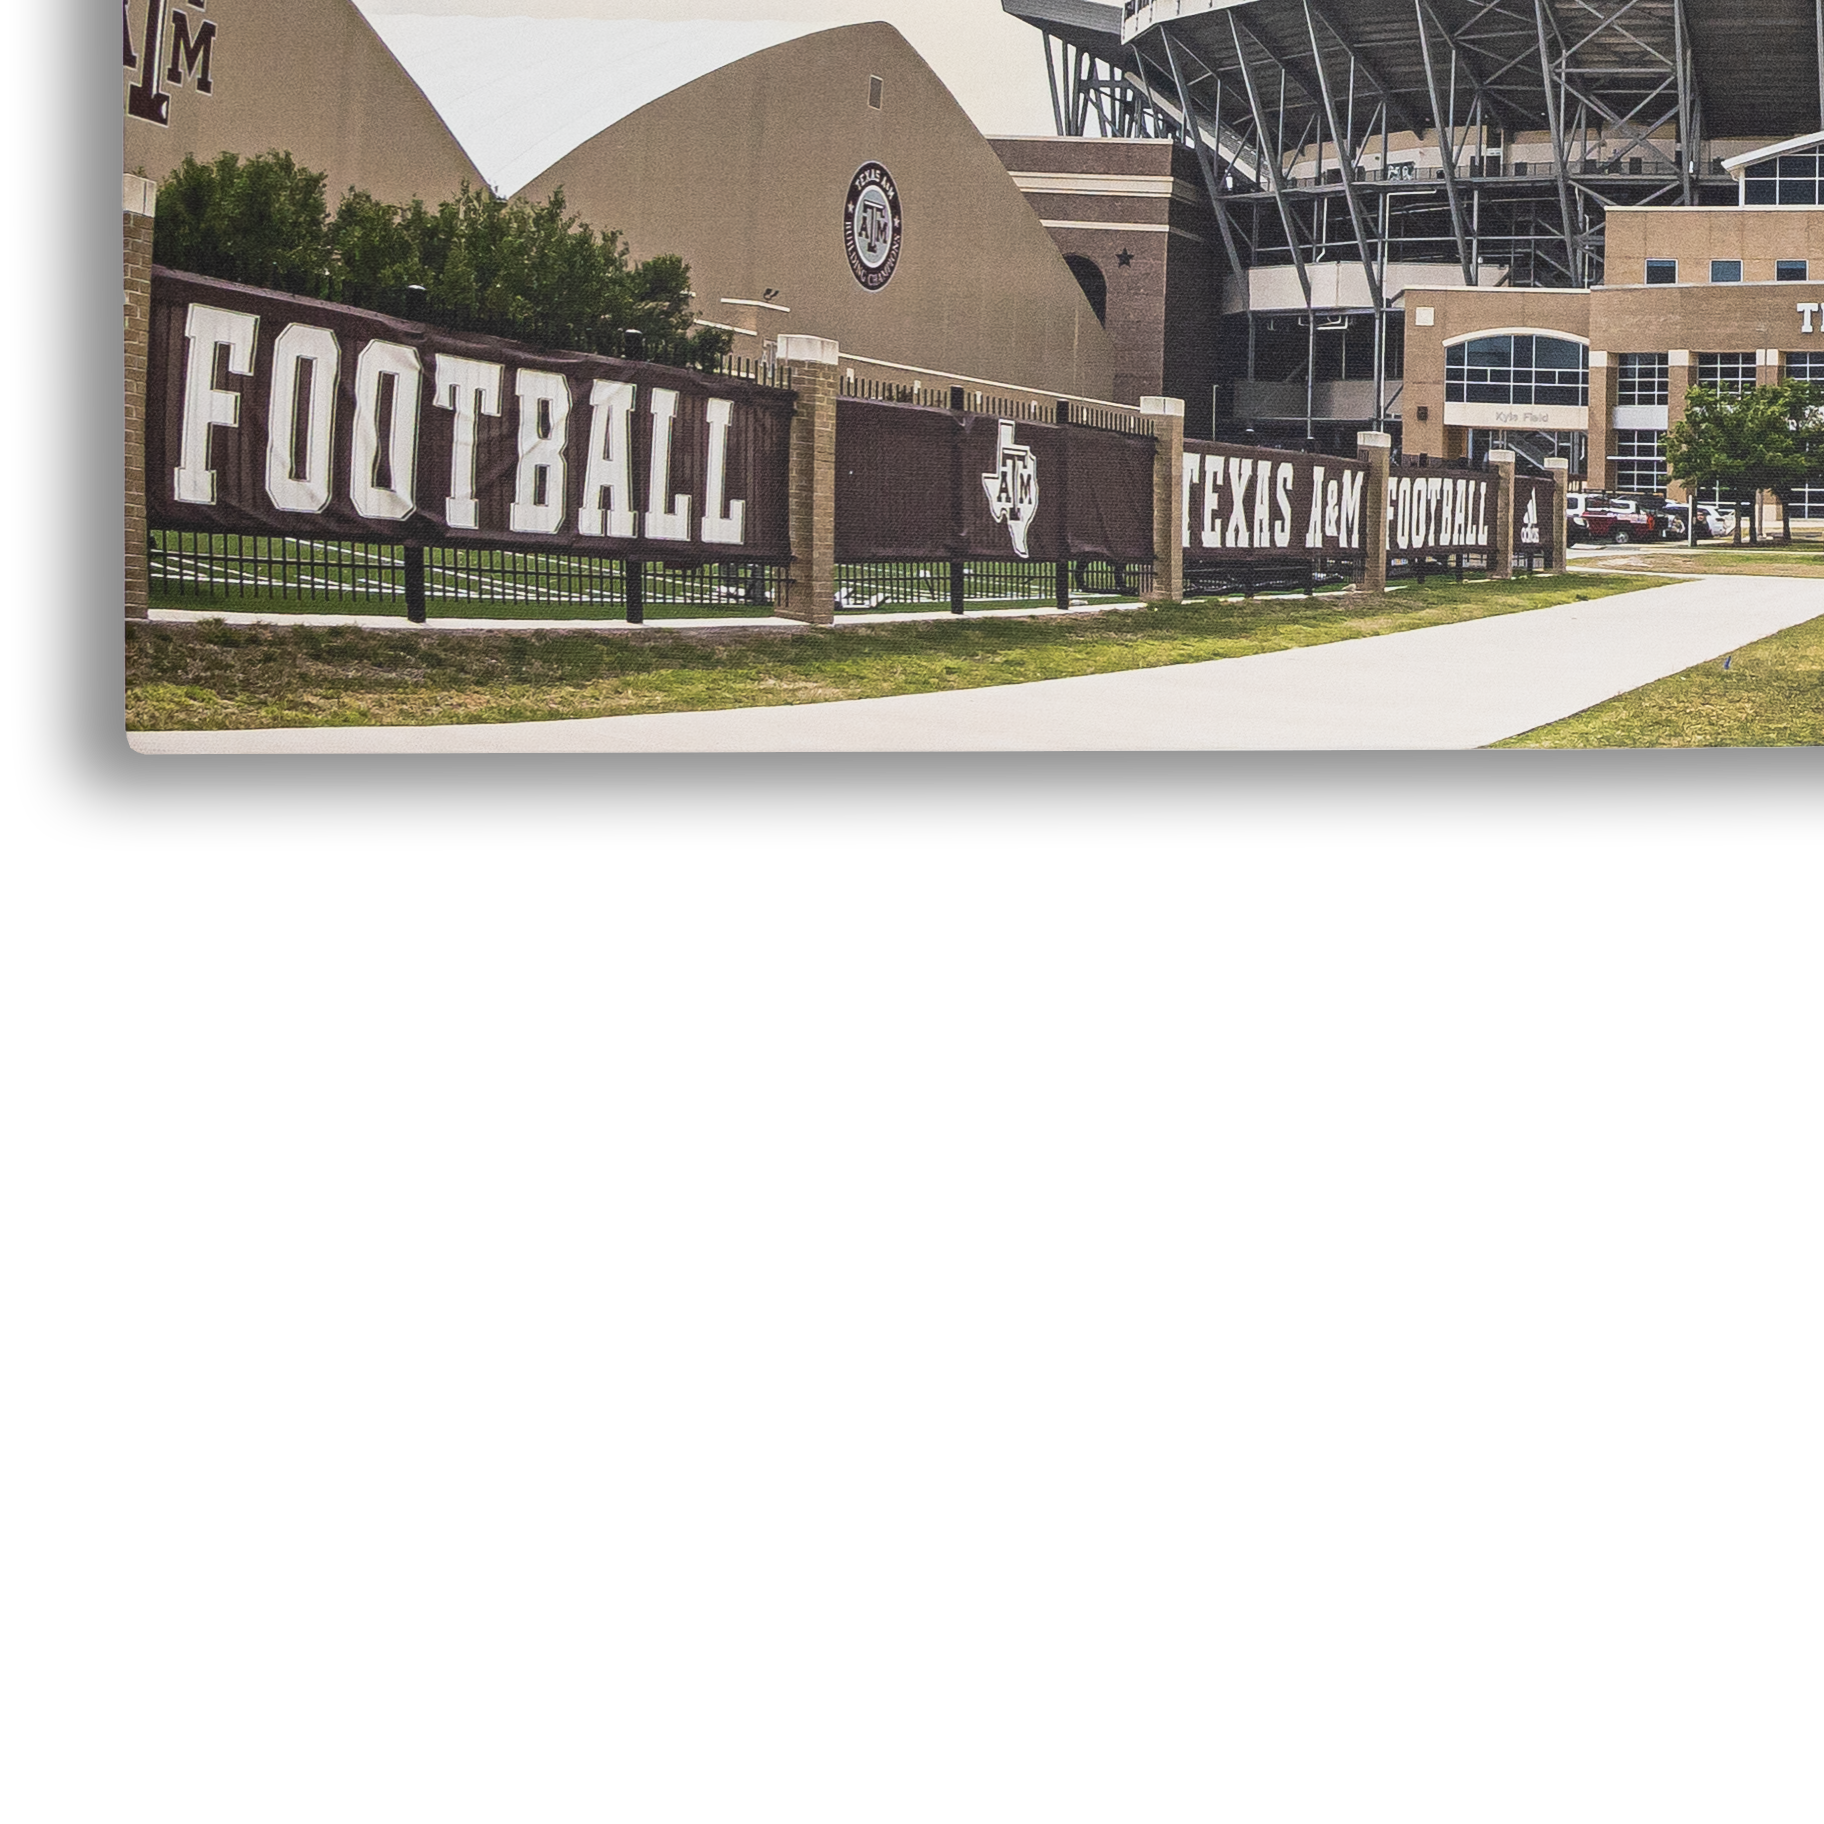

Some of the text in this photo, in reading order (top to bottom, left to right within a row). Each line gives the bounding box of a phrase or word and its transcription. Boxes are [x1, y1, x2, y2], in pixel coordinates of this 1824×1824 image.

[173, 302, 747, 545] FOOTBALL
[1182, 452, 1365, 549] TEXAS A&M
[1384, 477, 1488, 550] FOOTBALL
